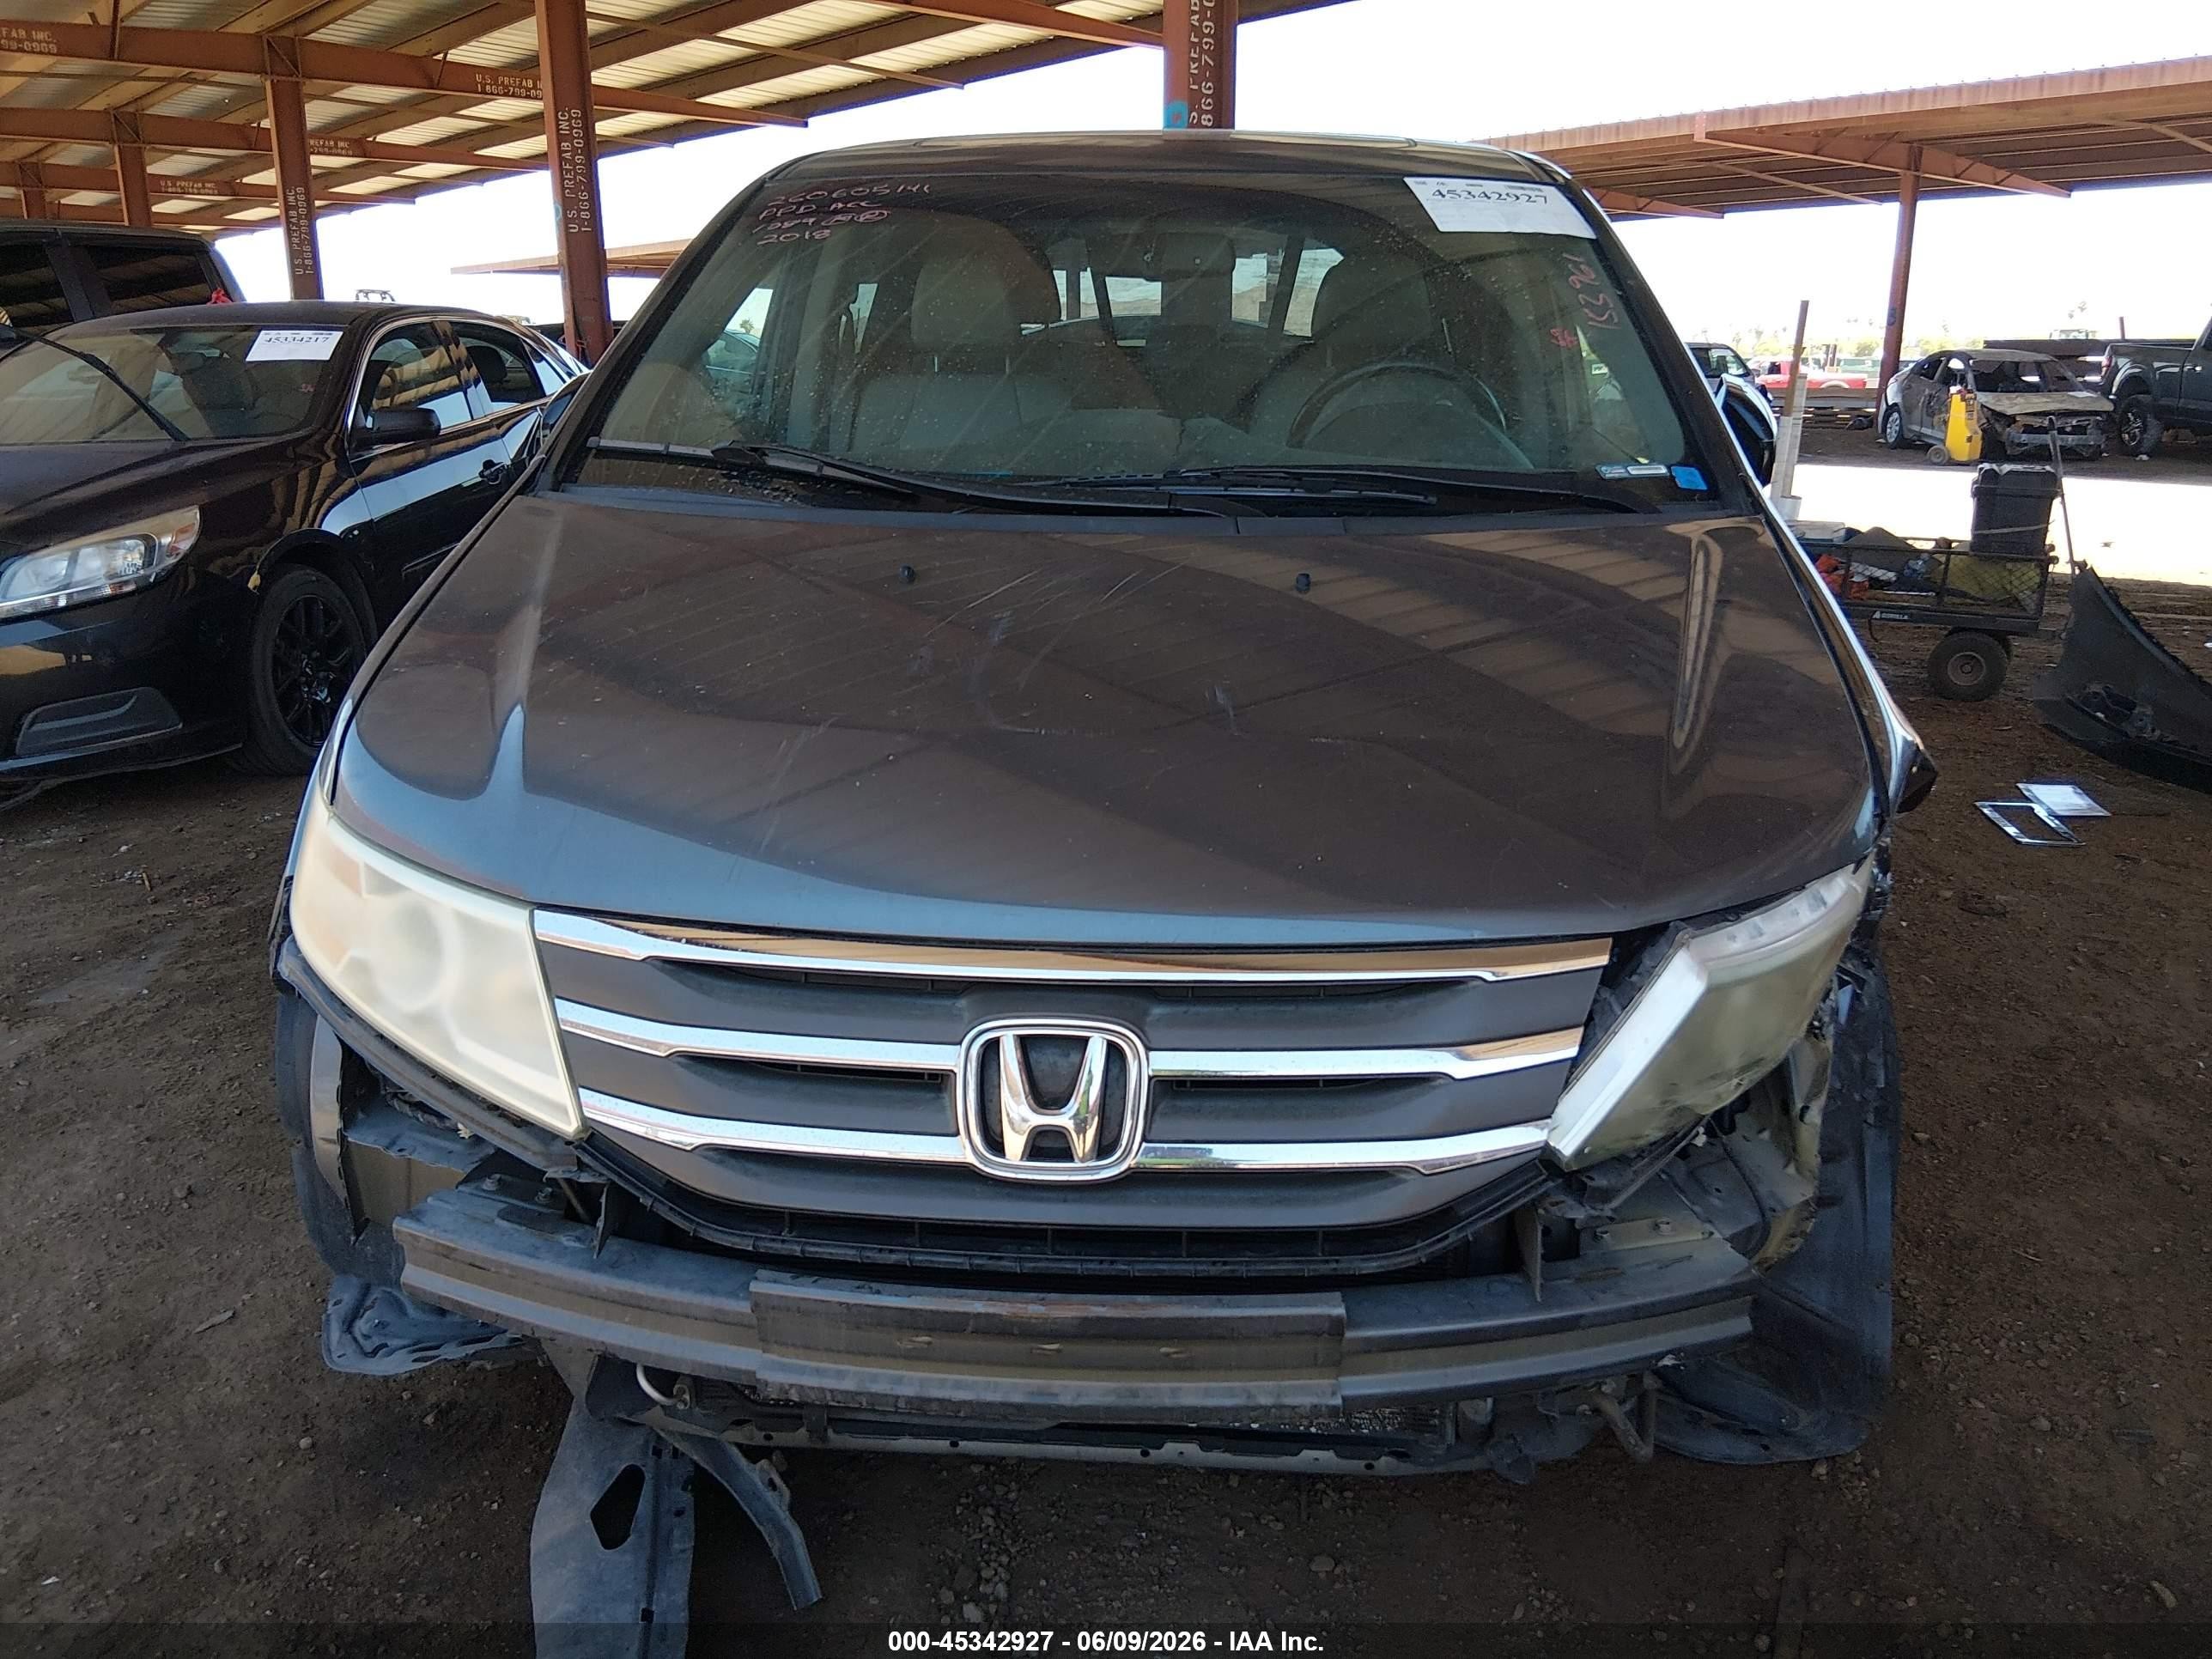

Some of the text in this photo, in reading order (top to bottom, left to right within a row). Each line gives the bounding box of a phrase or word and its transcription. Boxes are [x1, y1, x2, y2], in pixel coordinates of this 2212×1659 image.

[476, 73, 494, 84] U.S.
[498, 76, 533, 88] PREFAB
[558, 107, 579, 233] U.S. PREFAB INC.
[571, 109, 592, 232] 1-866-799-0969
[286, 185, 296, 206] INC.
[1432, 189, 1547, 204] 45342927
[289, 210, 301, 250] PREFAB
[757, 229, 831, 245] 2018
